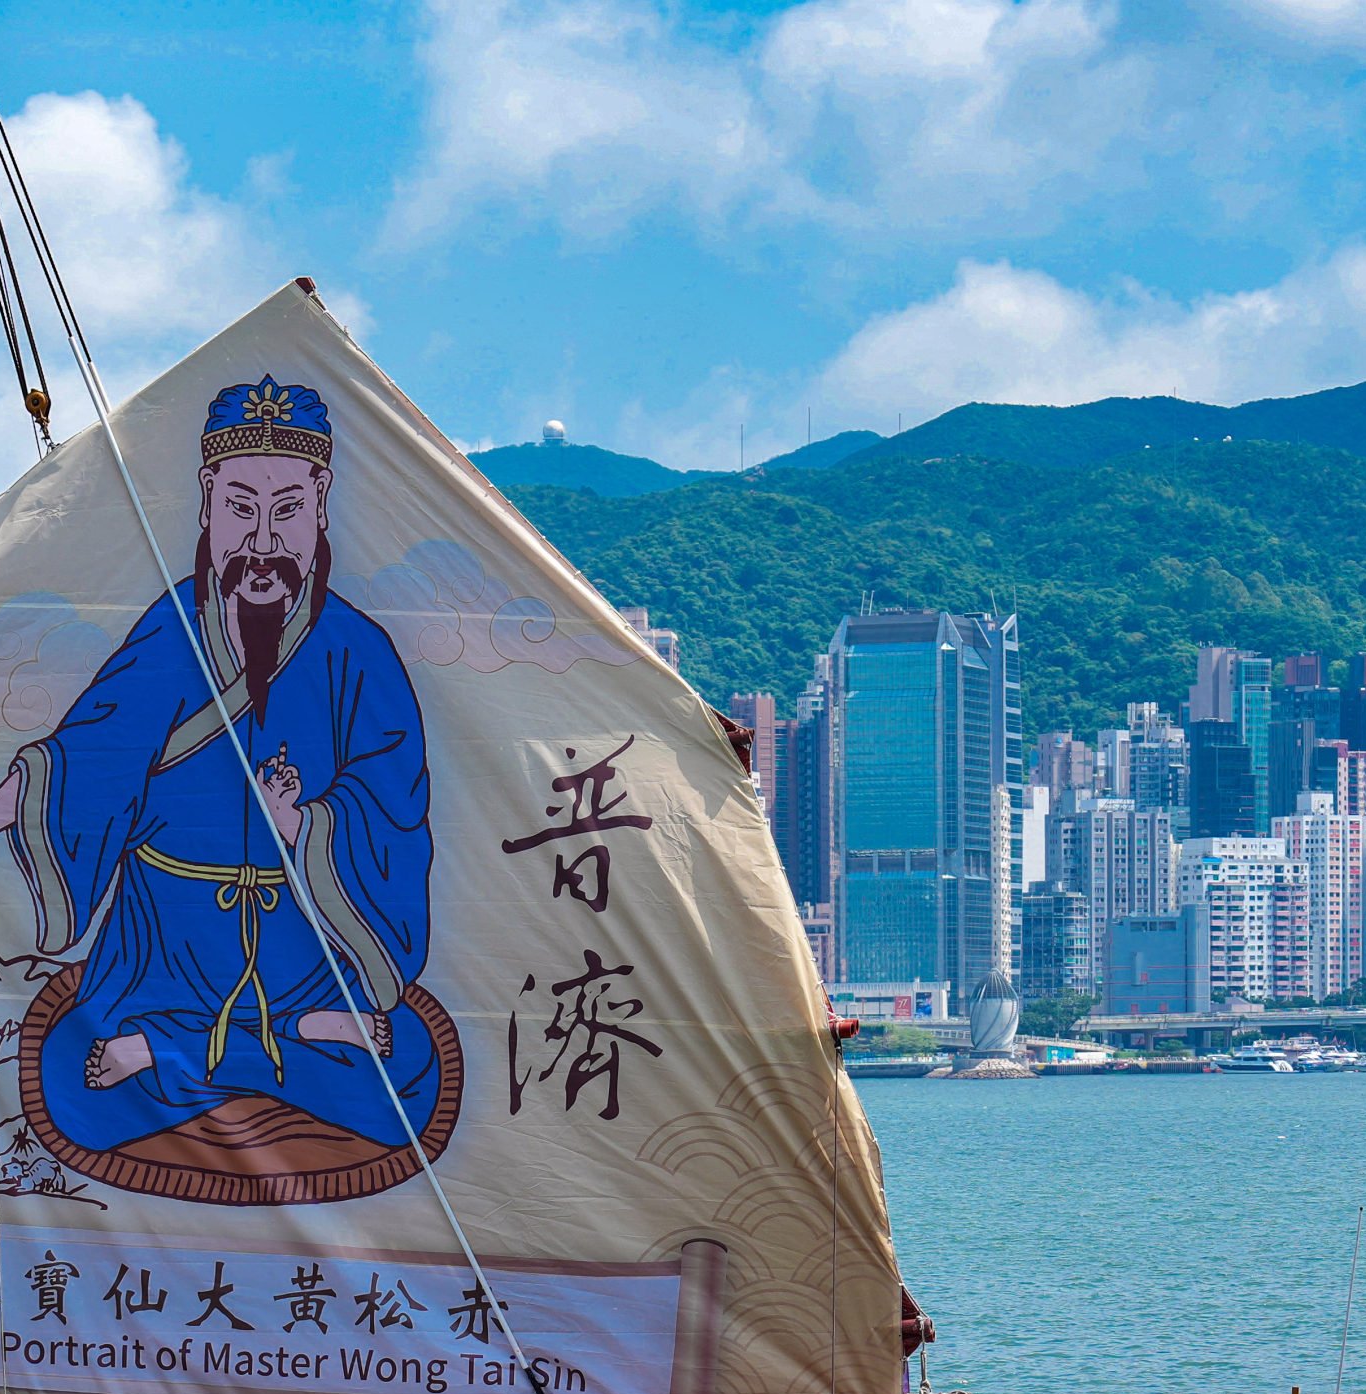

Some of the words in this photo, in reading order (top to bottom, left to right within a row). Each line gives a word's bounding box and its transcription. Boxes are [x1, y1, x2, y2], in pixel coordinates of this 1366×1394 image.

[502, 734, 663, 1120] 普濟
[2, 1331, 147, 1369] Portrait
[156, 1338, 193, 1372] of
[203, 1342, 330, 1379] Master
[340, 1348, 448, 1394] Wong
[460, 1353, 516, 1386] Tai
[530, 1357, 586, 1392] Sin
